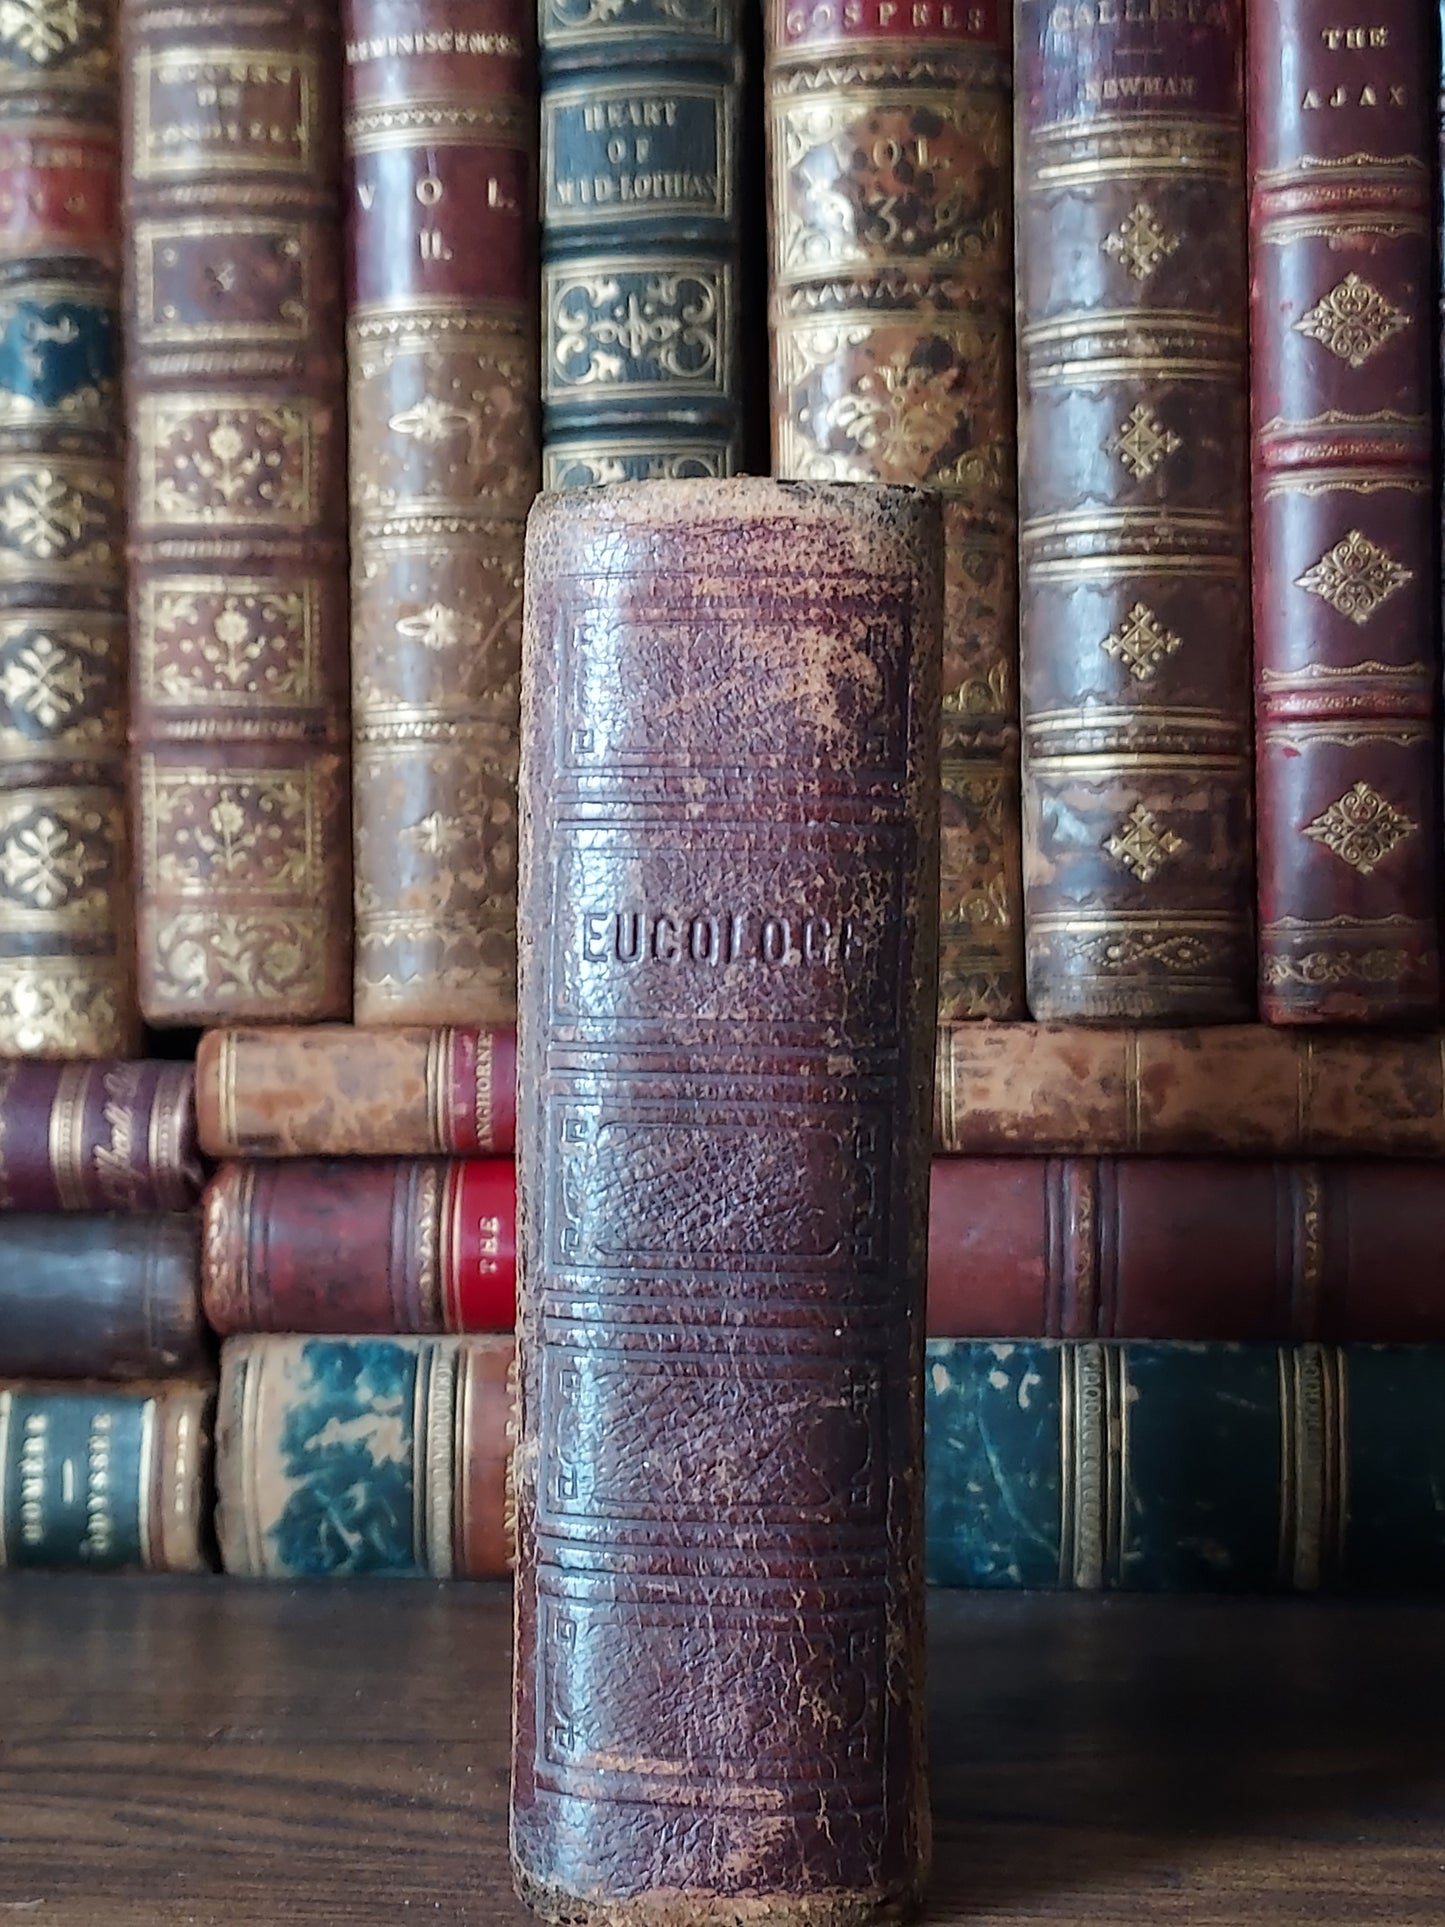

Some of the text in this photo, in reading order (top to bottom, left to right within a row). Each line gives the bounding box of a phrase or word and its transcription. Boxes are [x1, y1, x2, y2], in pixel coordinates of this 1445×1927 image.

[787, 2, 984, 34] GOSPELS
[1322, 26, 1388, 50] THE
[1085, 76, 1198, 102] NEWMAN
[1303, 83, 1408, 110] AJAX
[584, 100, 677, 131] HEART
[607, 138, 650, 164] OF
[479, 1215, 500, 1276] THE
